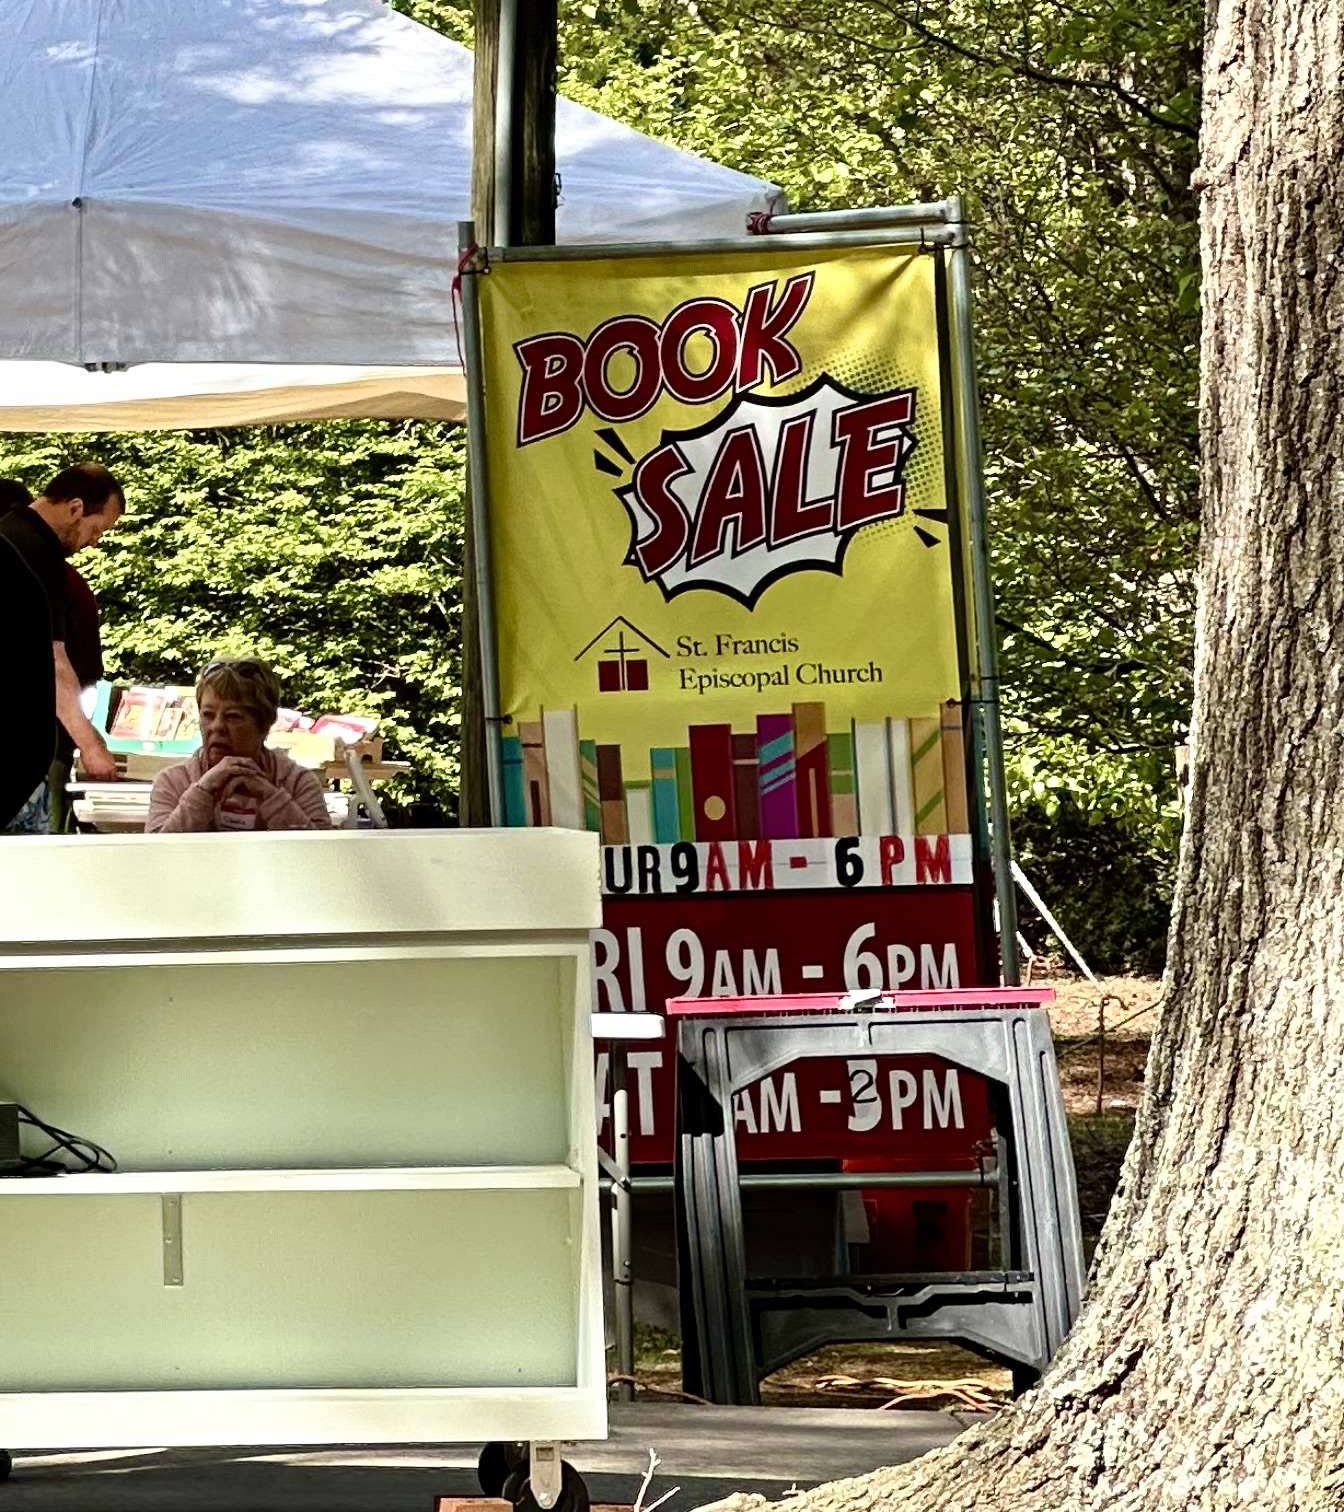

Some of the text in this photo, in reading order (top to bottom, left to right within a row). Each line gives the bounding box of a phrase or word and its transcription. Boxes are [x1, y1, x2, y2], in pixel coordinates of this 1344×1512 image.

[514, 270, 815, 447] BOOK
[633, 388, 916, 582] SALE
[676, 631, 800, 657] St. Francis
[679, 661, 883, 694] Episcopal Church
